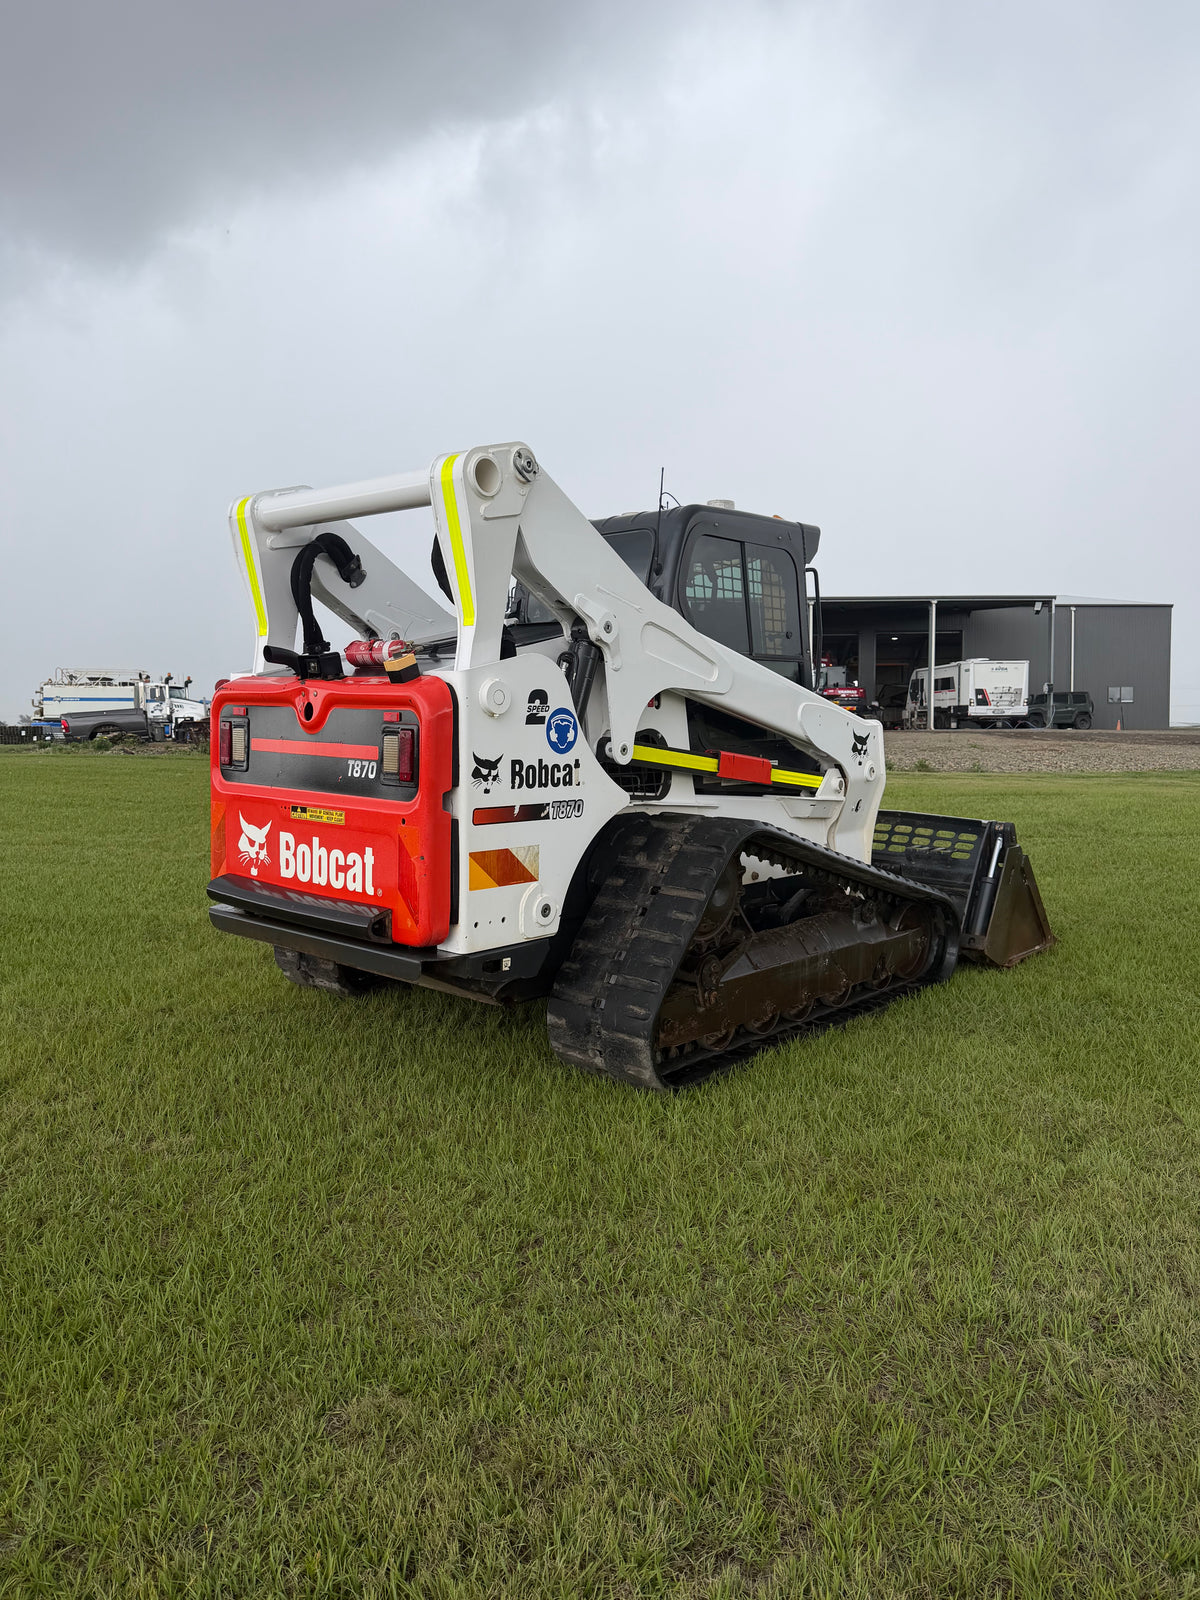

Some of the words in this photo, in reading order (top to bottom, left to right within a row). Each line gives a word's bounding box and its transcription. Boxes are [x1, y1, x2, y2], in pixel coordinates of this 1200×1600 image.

[525, 688, 549, 725] 2
[526, 705, 550, 713] SPEED
[348, 759, 377, 779] T870
[510, 758, 581, 790] Bobcat
[551, 799, 584, 820] T870
[279, 831, 375, 896] Bobcat
